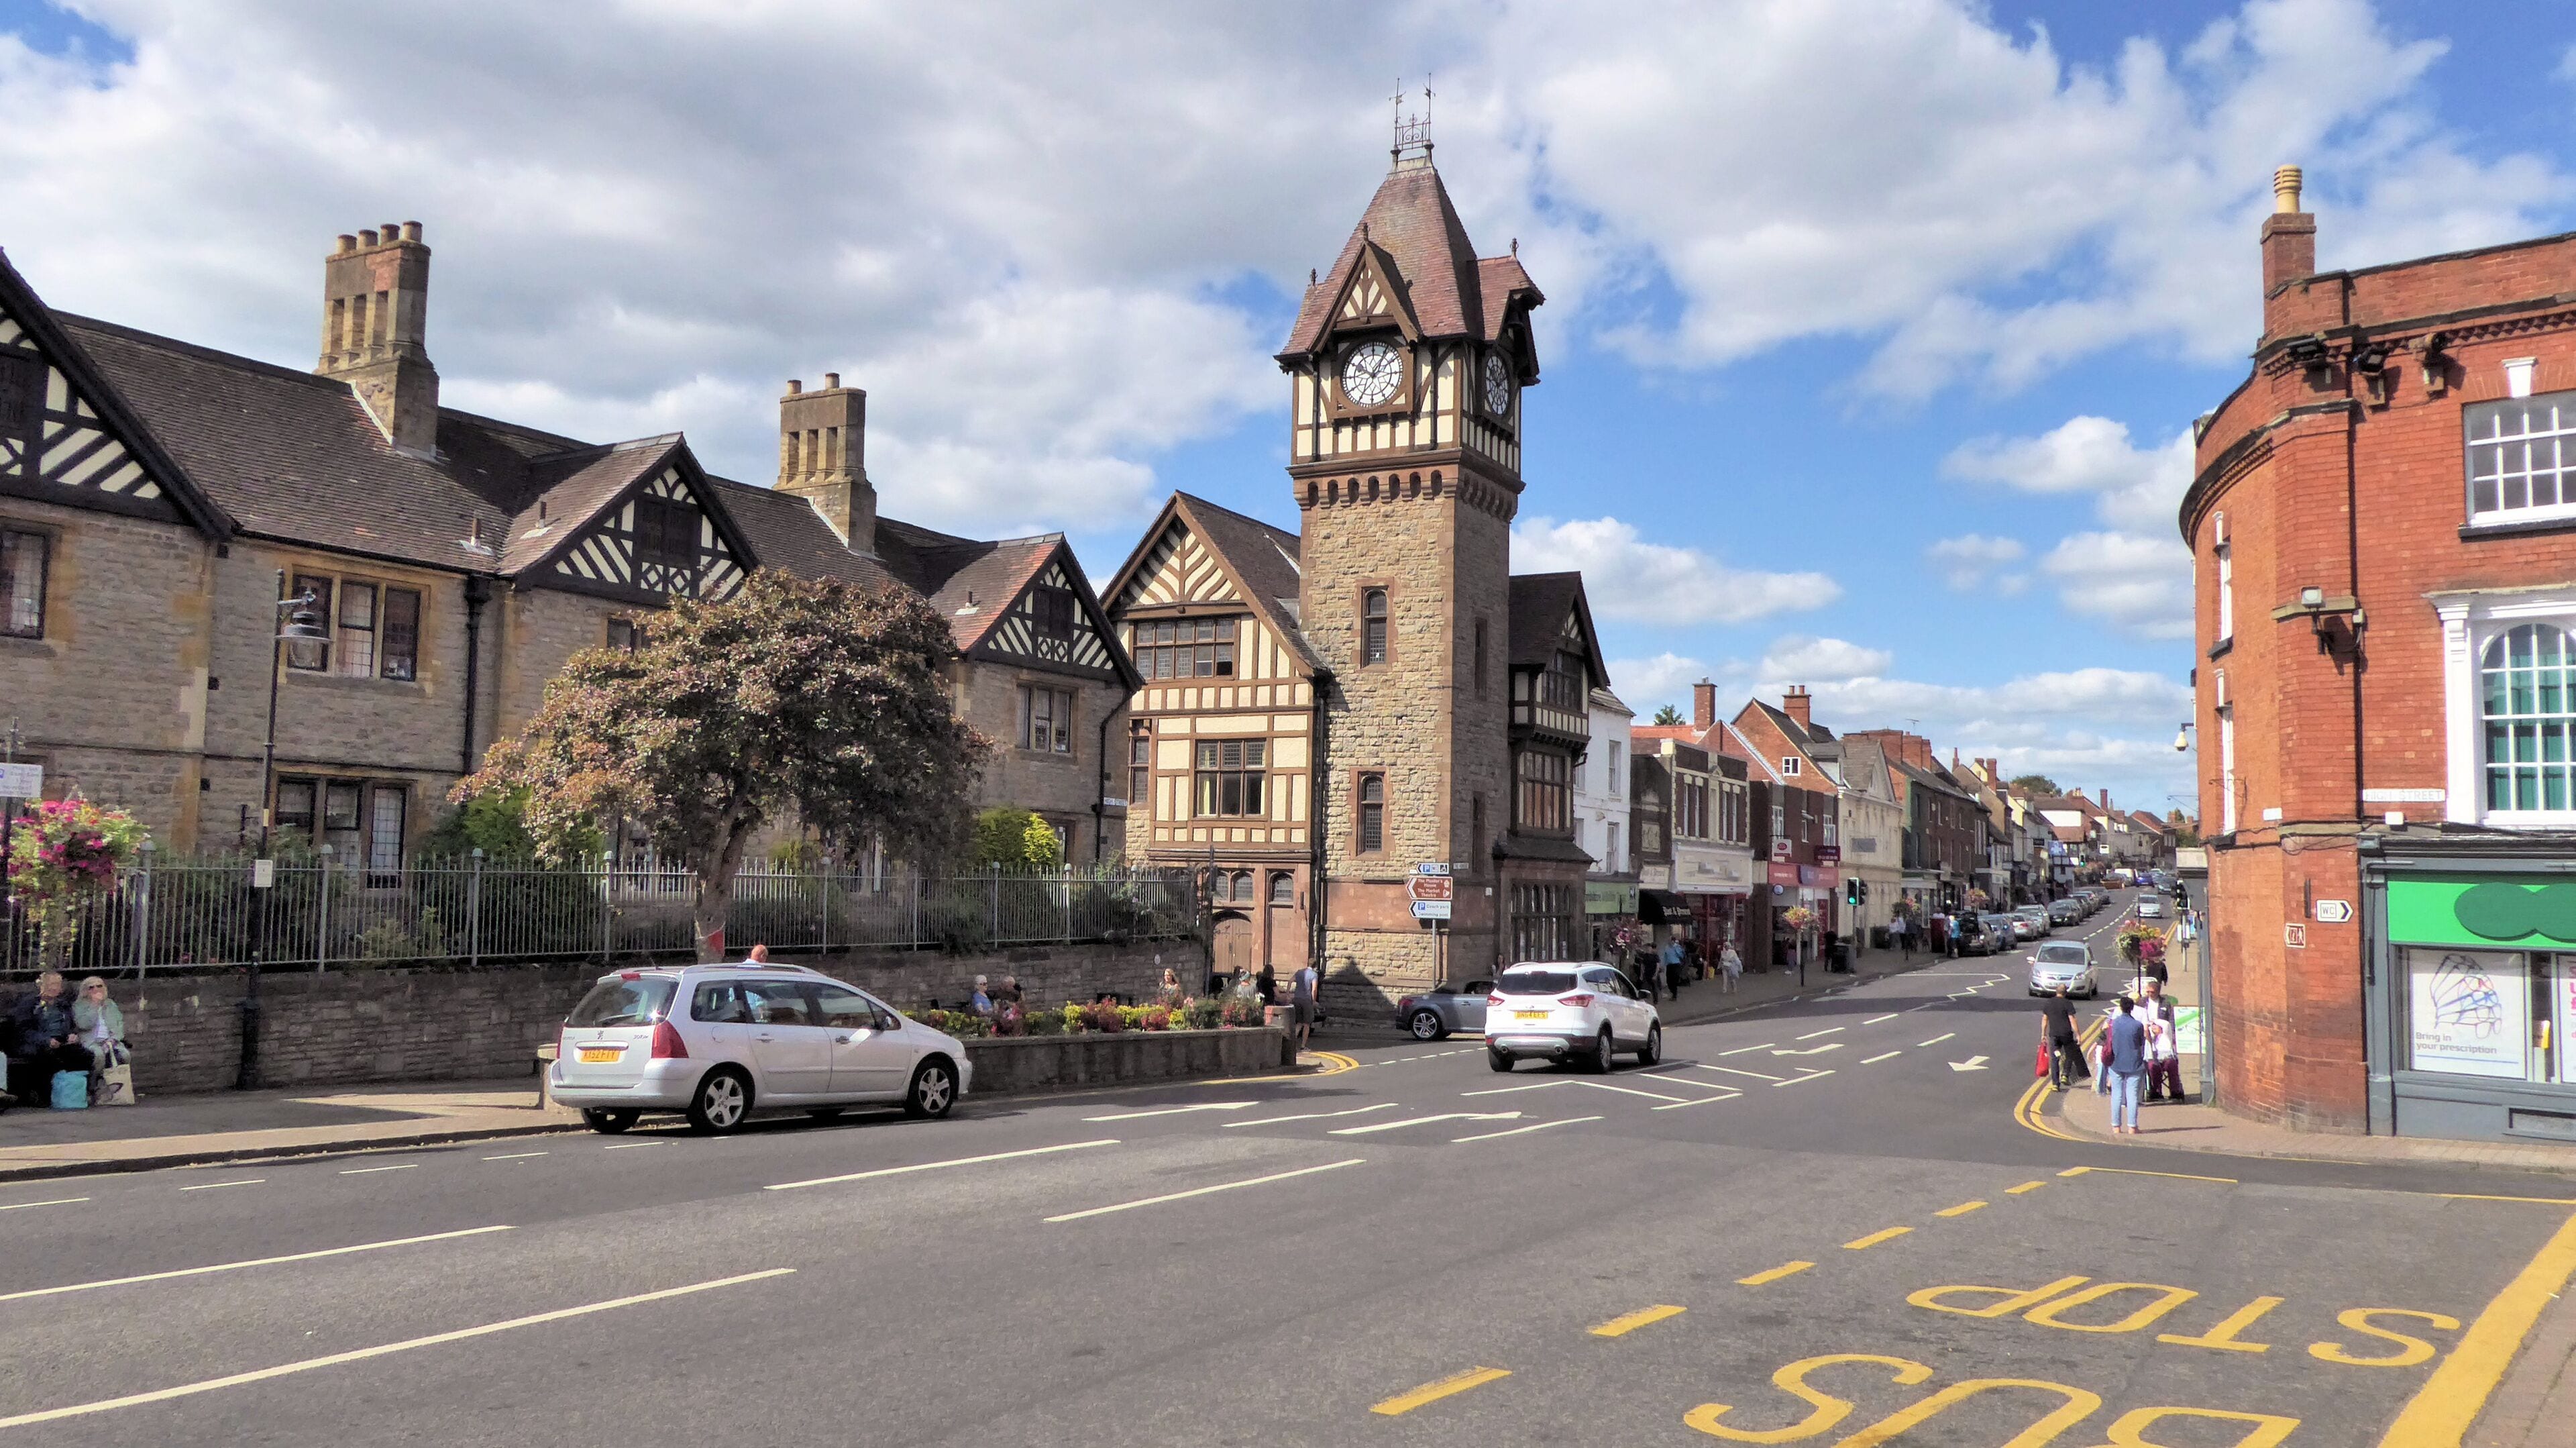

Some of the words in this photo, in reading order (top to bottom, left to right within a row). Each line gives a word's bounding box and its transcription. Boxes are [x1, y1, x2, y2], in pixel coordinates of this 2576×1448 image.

[2365, 791, 2392, 800] HIGH
[2399, 790, 2442, 800] STREET
[2322, 907, 2335, 915] WC
[2415, 1031, 2440, 1043] Bring
[2443, 1033, 2452, 1041] in
[2439, 1044, 2498, 1054] prescription
[1907, 1276, 2463, 1368] STOP
